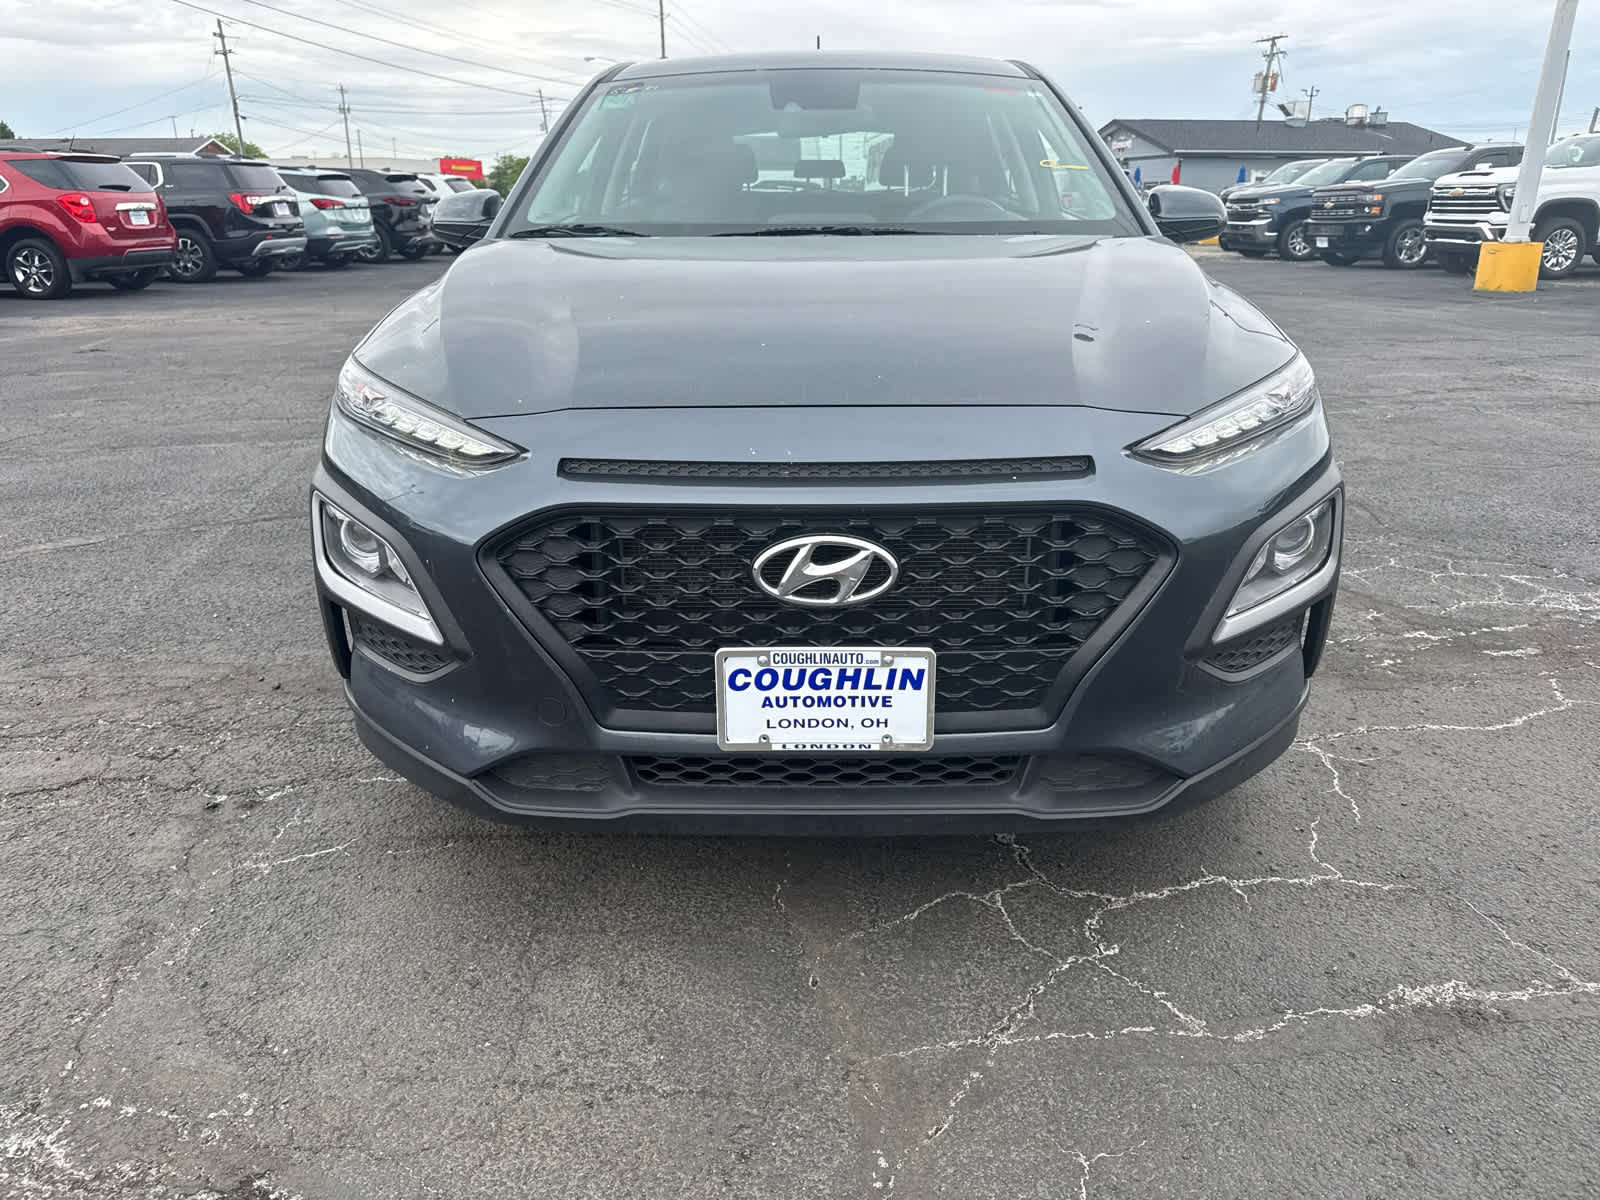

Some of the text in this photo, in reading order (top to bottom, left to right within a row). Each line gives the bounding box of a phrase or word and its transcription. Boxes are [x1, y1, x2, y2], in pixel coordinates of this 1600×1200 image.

[727, 667, 926, 692] COUGHLIN
[761, 695, 893, 708] AUTOMOTIVE
[766, 717, 889, 730] LONDON, OH
